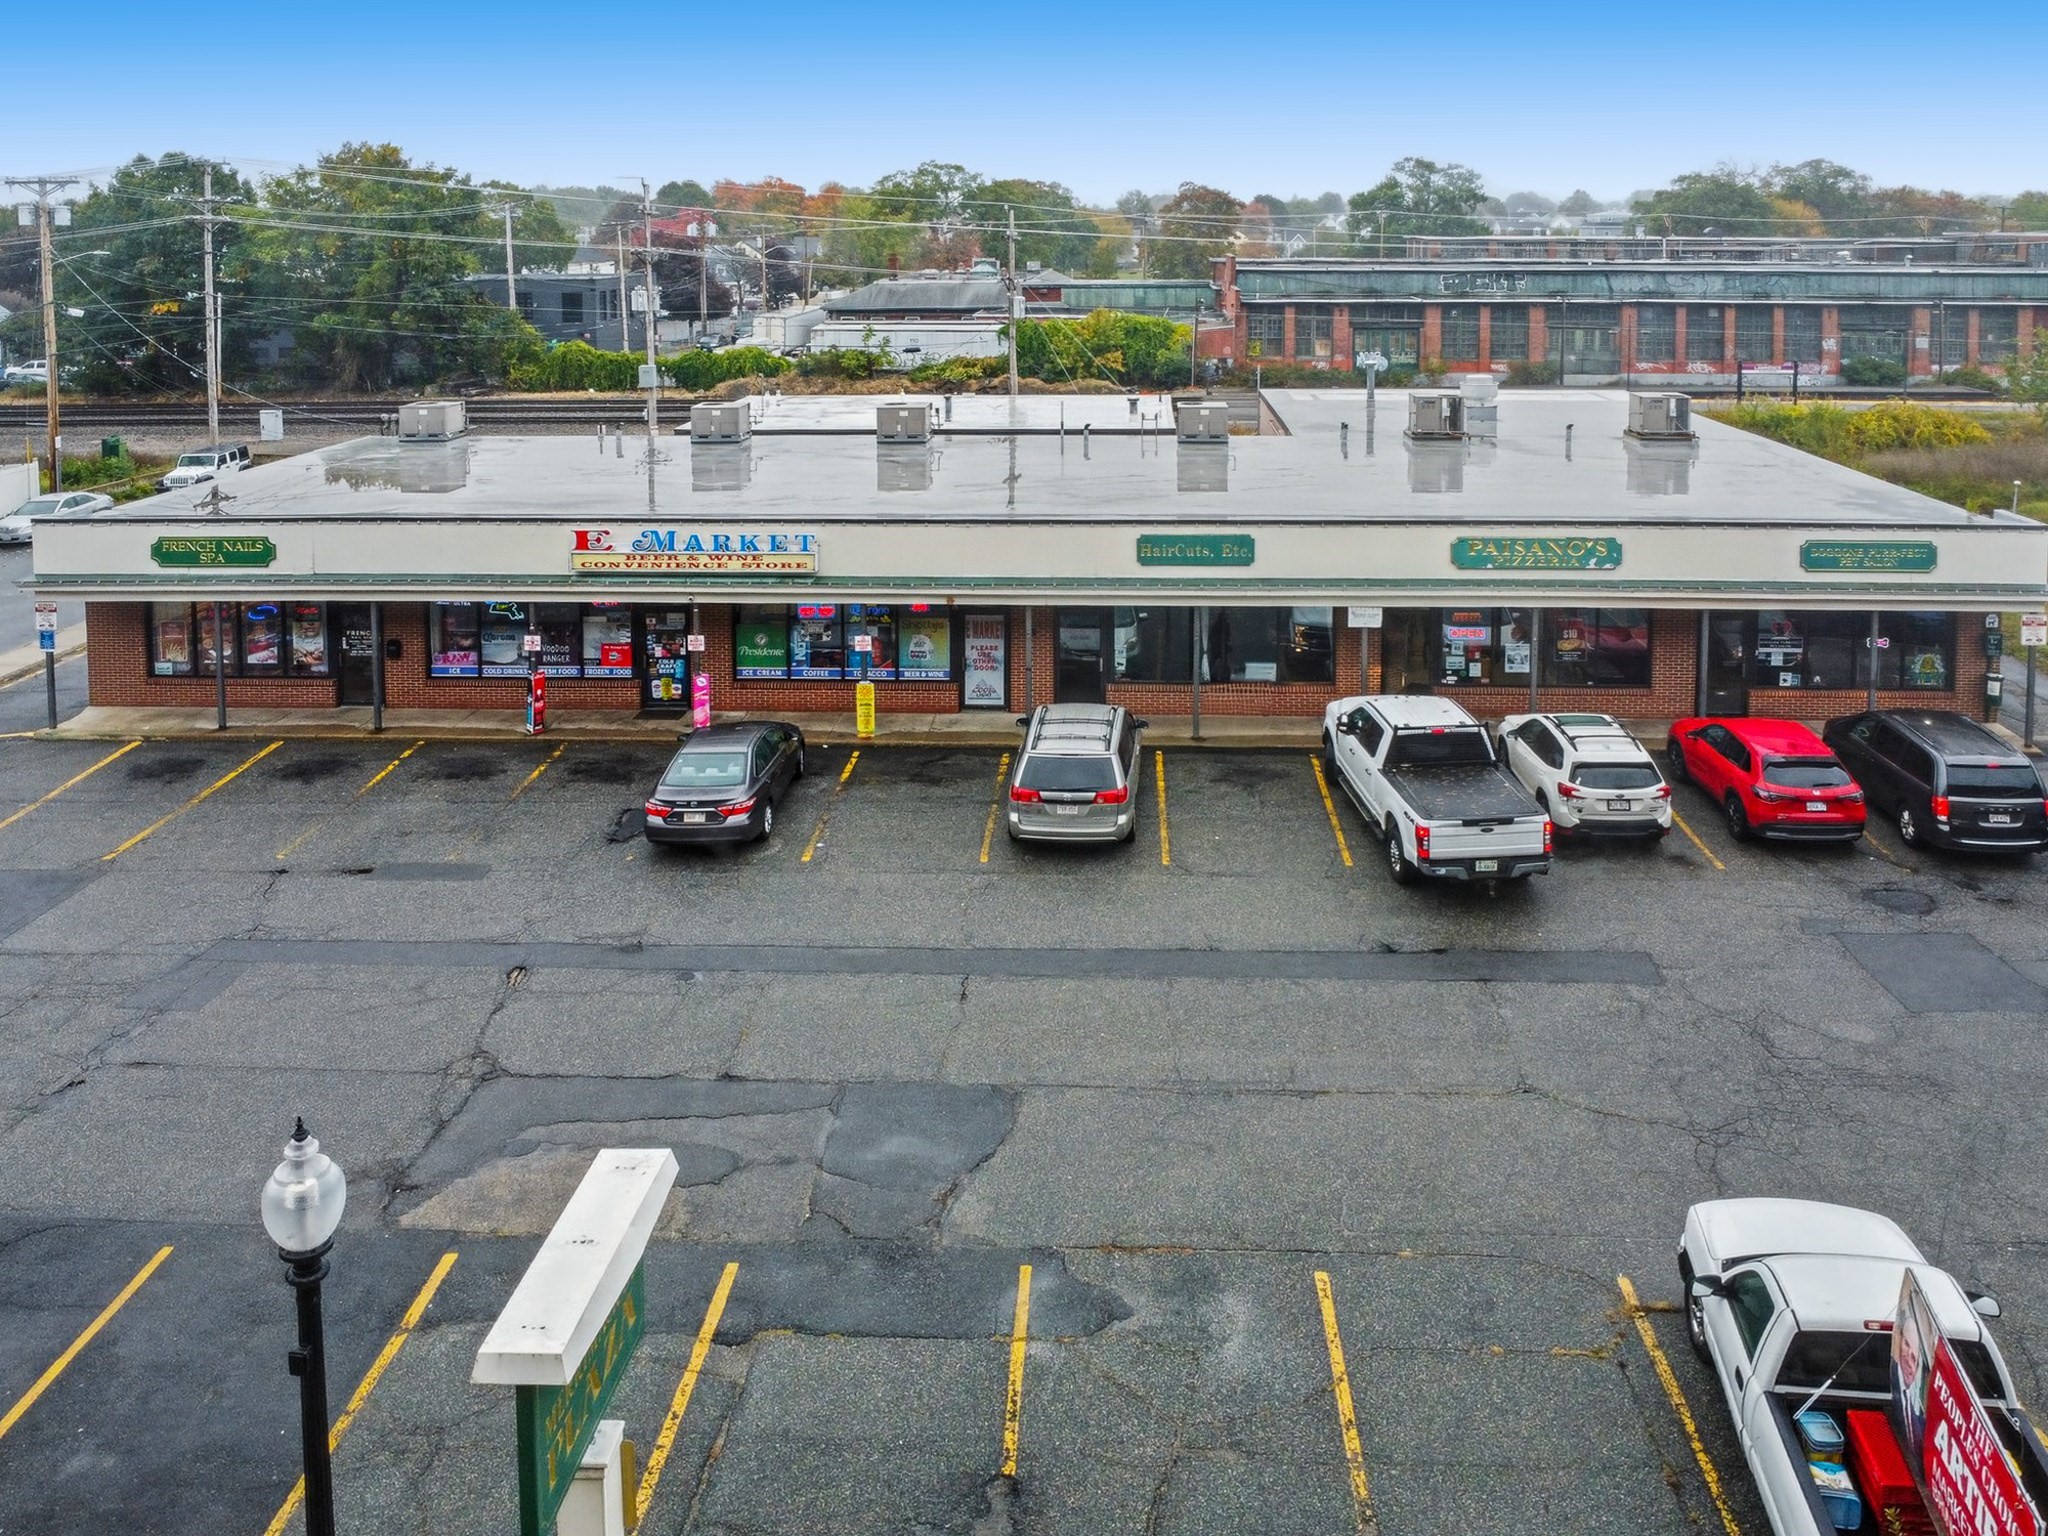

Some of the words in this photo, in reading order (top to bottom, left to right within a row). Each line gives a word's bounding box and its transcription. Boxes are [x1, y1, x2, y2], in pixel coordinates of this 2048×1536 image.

[162, 541, 216, 552] FRENCH
[223, 541, 264, 552] NAILS
[571, 530, 614, 552] E
[632, 530, 817, 552] MARKET
[1140, 543, 1214, 558] HairCuts,
[1221, 543, 1253, 558] Etc.
[1468, 540, 1608, 556] PAISANO'S
[199, 552, 226, 564] SPA
[624, 554, 681, 562] BEER
[686, 554, 700, 562] &
[708, 554, 764, 562] WINE
[1495, 556, 1580, 566] PIZZERIA
[580, 561, 729, 569] CONVENIENCE
[740, 561, 809, 569] STORE
[1449, 628, 1486, 639] OPEN
[1562, 629, 1578, 639] $10
[738, 645, 785, 656] Presidente
[1933, 1370, 1981, 1471] PEOPLES
[1969, 1405, 1995, 1466] THE
